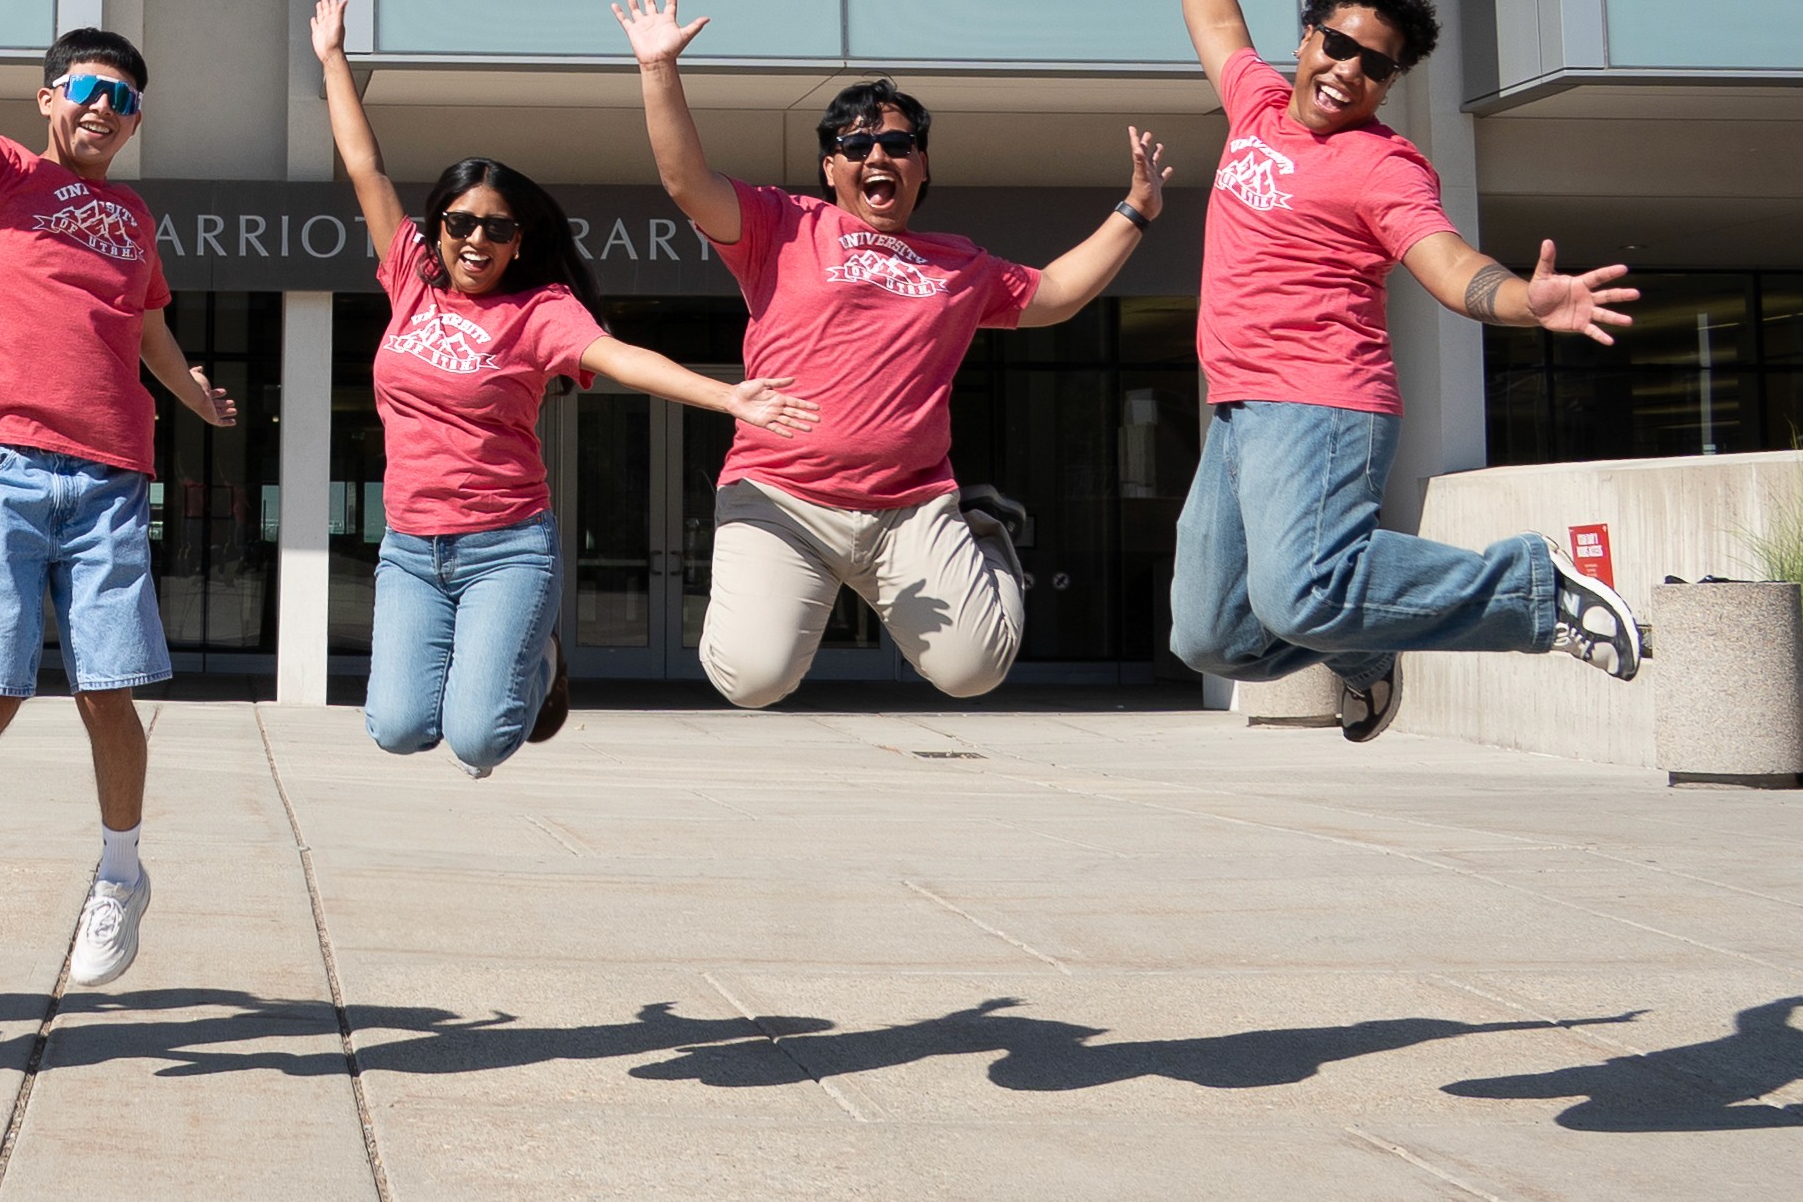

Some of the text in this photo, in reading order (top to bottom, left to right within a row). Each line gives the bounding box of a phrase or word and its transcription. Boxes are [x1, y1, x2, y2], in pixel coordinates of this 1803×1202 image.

[59, 218, 78, 233] OF
[567, 217, 710, 261] RARY
[838, 231, 929, 265] UNIVERSITY
